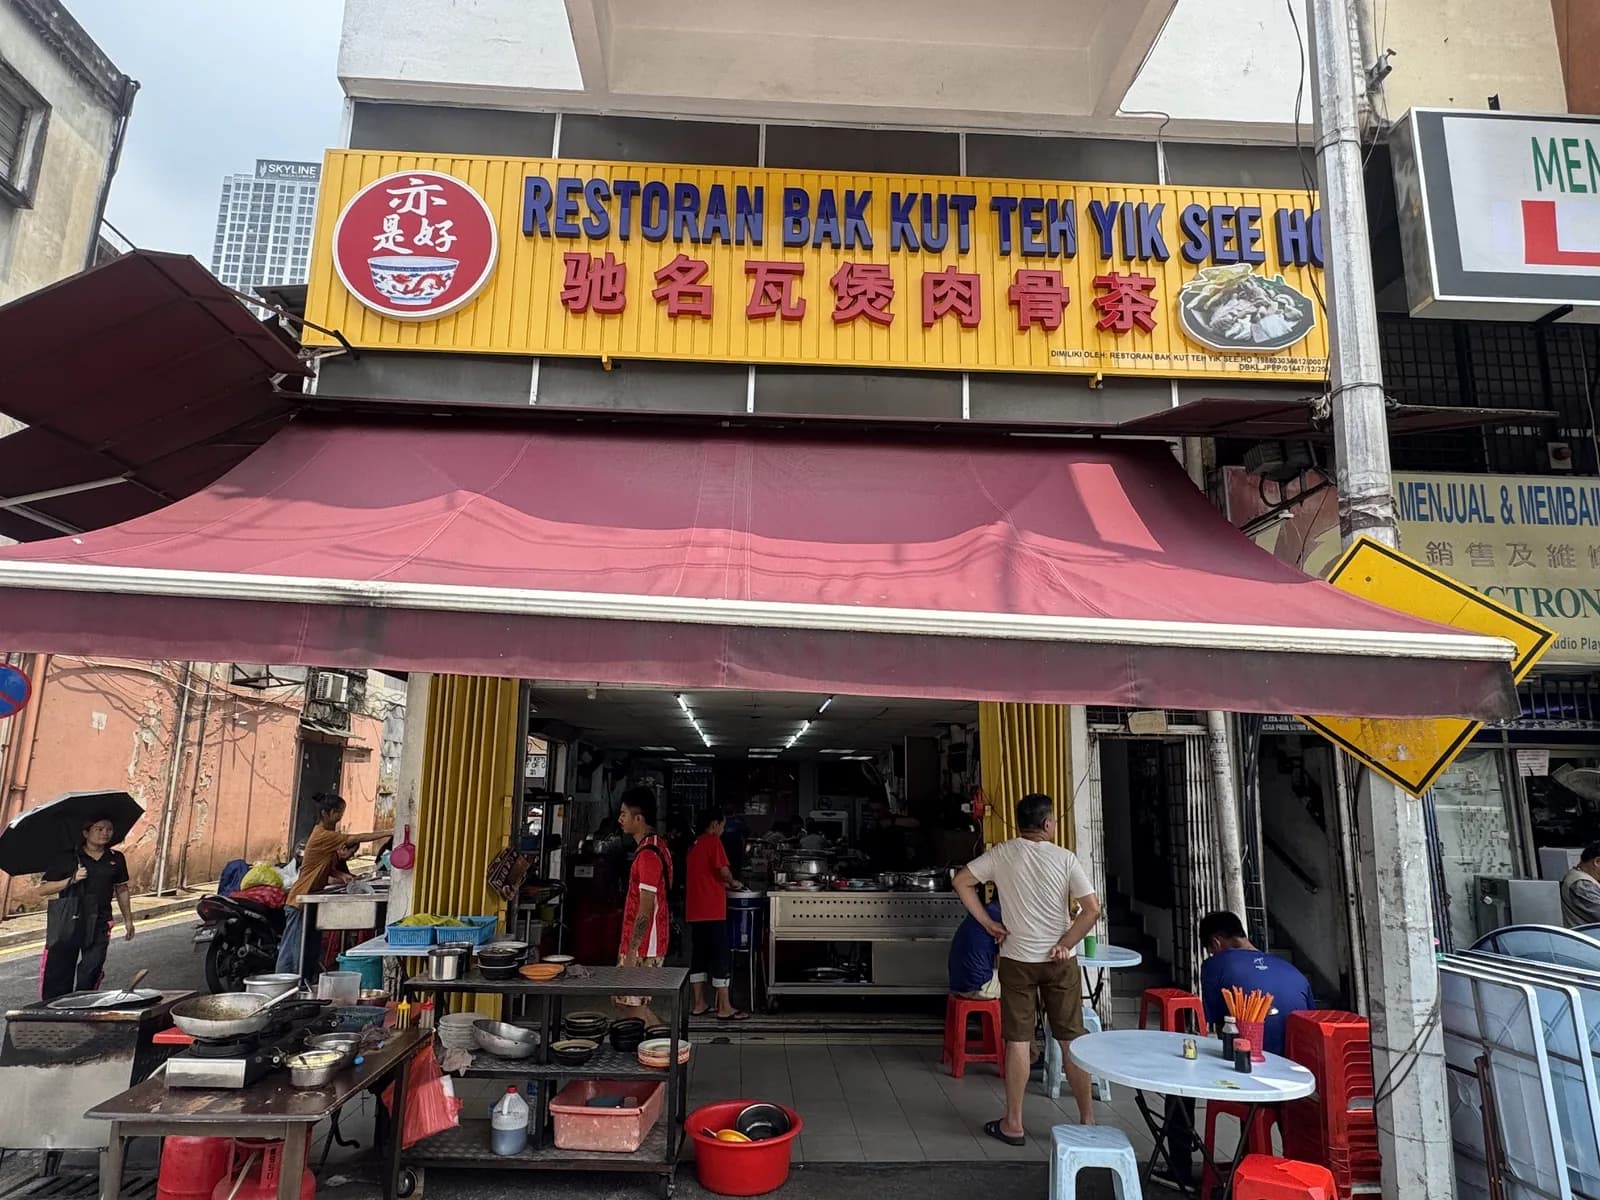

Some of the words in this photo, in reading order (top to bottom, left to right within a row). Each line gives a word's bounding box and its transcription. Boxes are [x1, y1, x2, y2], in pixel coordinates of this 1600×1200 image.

[268, 163, 317, 176] SKYLINE
[386, 177, 448, 217] 亦
[522, 176, 764, 247] RESTORAN
[783, 187, 874, 250] BAK
[890, 191, 977, 254] KUT
[991, 196, 1077, 259] TEH
[1088, 200, 1170, 262] YIK
[1180, 203, 1266, 265] SEE
[560, 252, 1158, 335] 驰名瓦煲肉骨茶
[1051, 350, 1082, 358] DIMILIKI
[1084, 351, 1107, 359] OLEH:
[1110, 352, 1153, 360] RESTORAN
[1155, 353, 1172, 361] BAK
[1173, 354, 1189, 362] KUT
[1191, 354, 1206, 362] TEH
[1208, 355, 1221, 363] YIK
[1240, 355, 1253, 363] HO
[1398, 481, 1496, 524] MENJUAL
[1500, 484, 1516, 525] &
